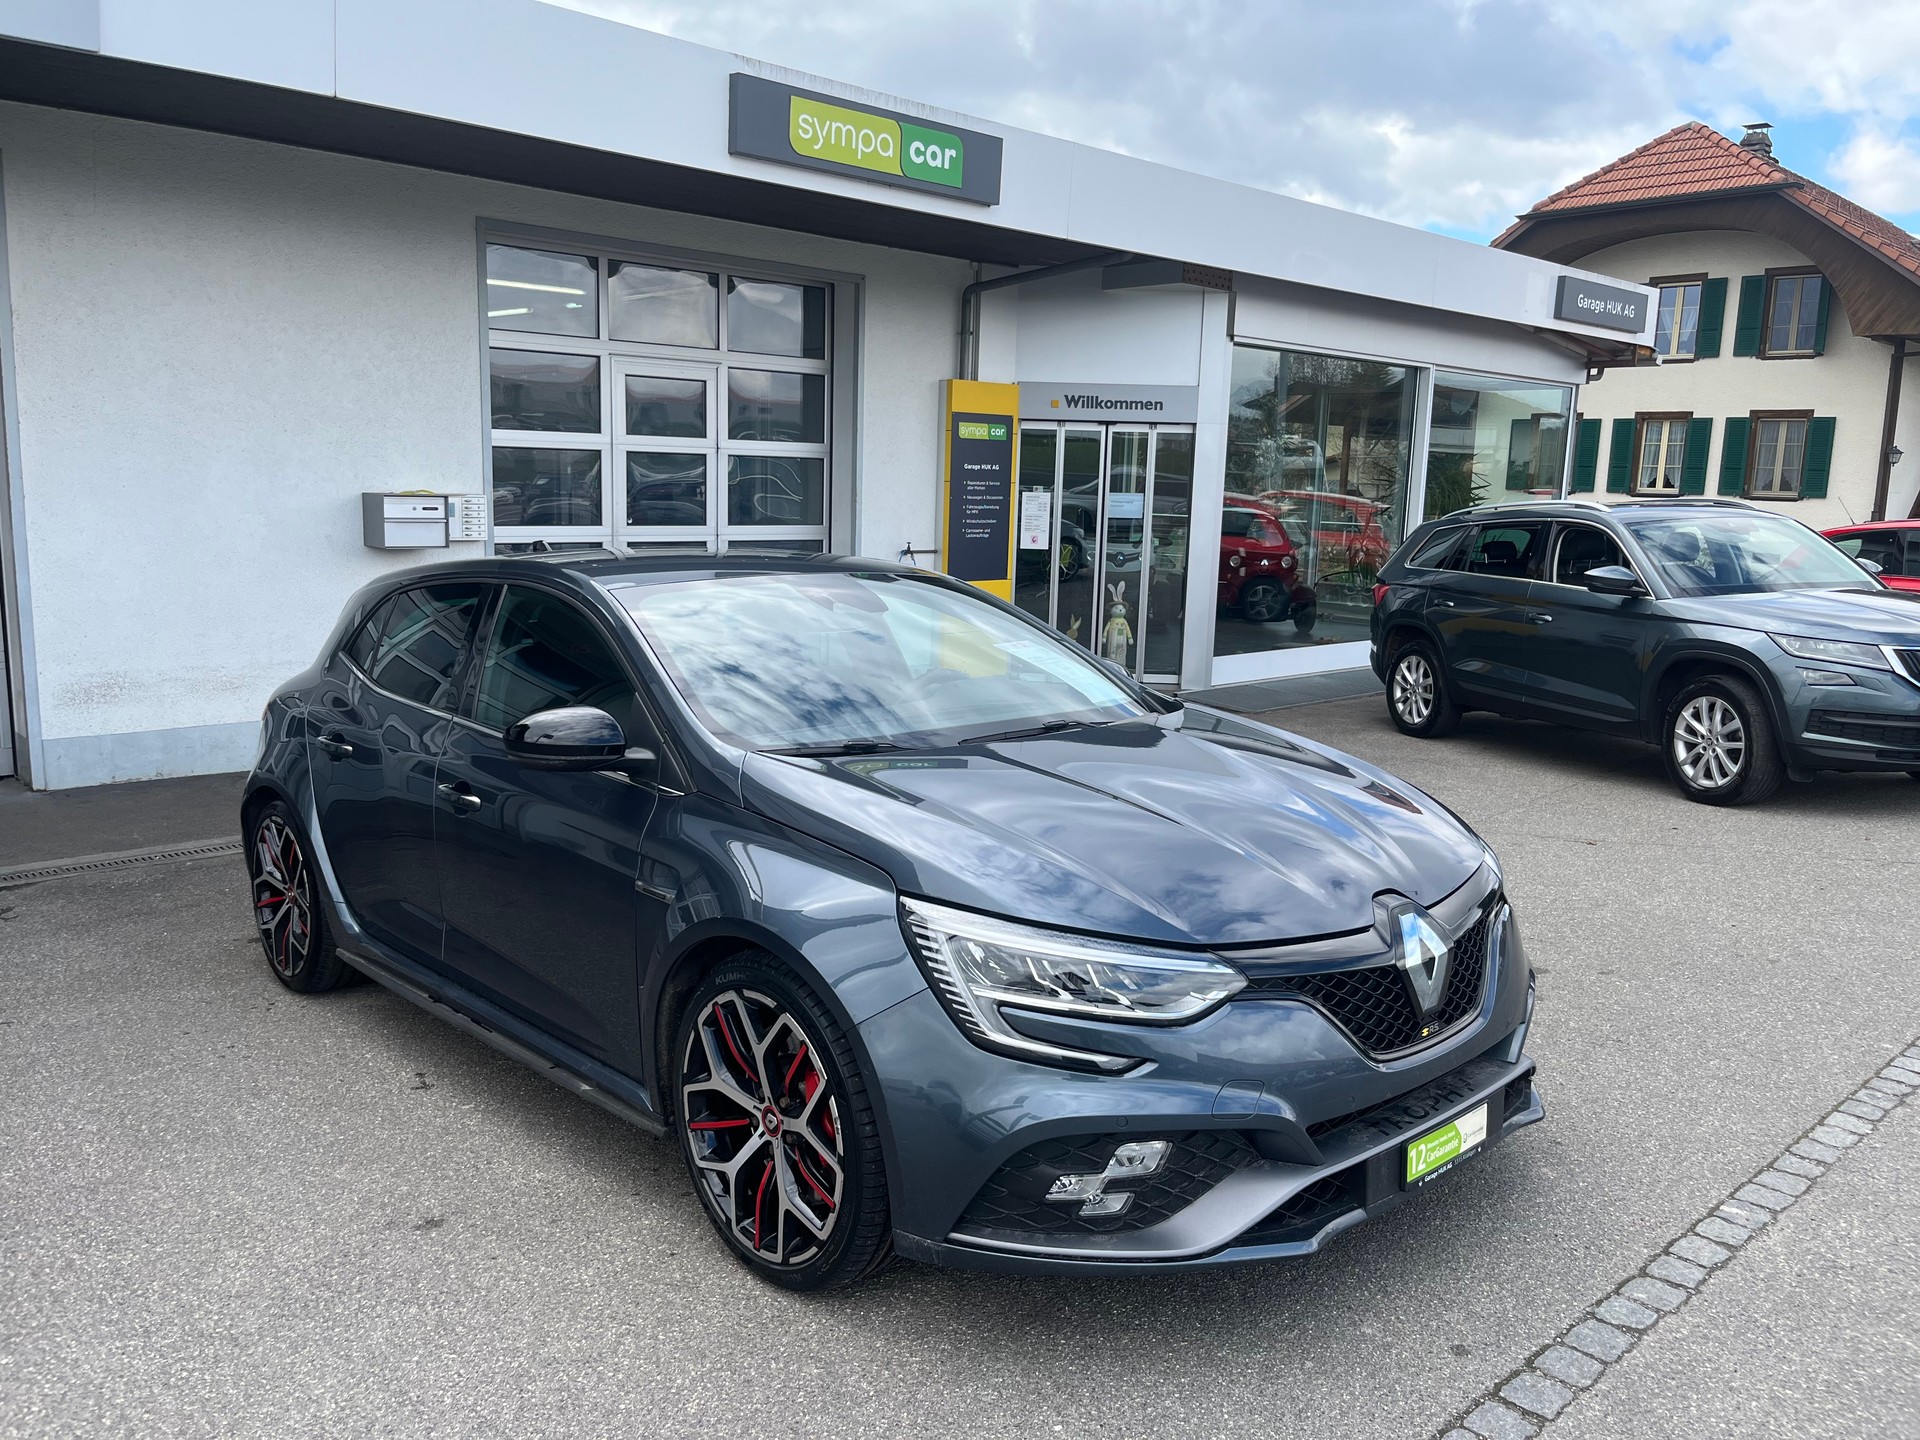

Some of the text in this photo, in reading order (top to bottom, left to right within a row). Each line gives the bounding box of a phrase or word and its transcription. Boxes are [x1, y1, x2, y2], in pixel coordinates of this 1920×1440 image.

[798, 113, 956, 169] sympa car
[1577, 294, 1635, 318] Garage HUK AG
[1064, 394, 1164, 411] Willkommen
[960, 426, 1005, 437] sympa car
[1409, 1143, 1427, 1175] 12
[1426, 1138, 1460, 1163] CarGarantie
